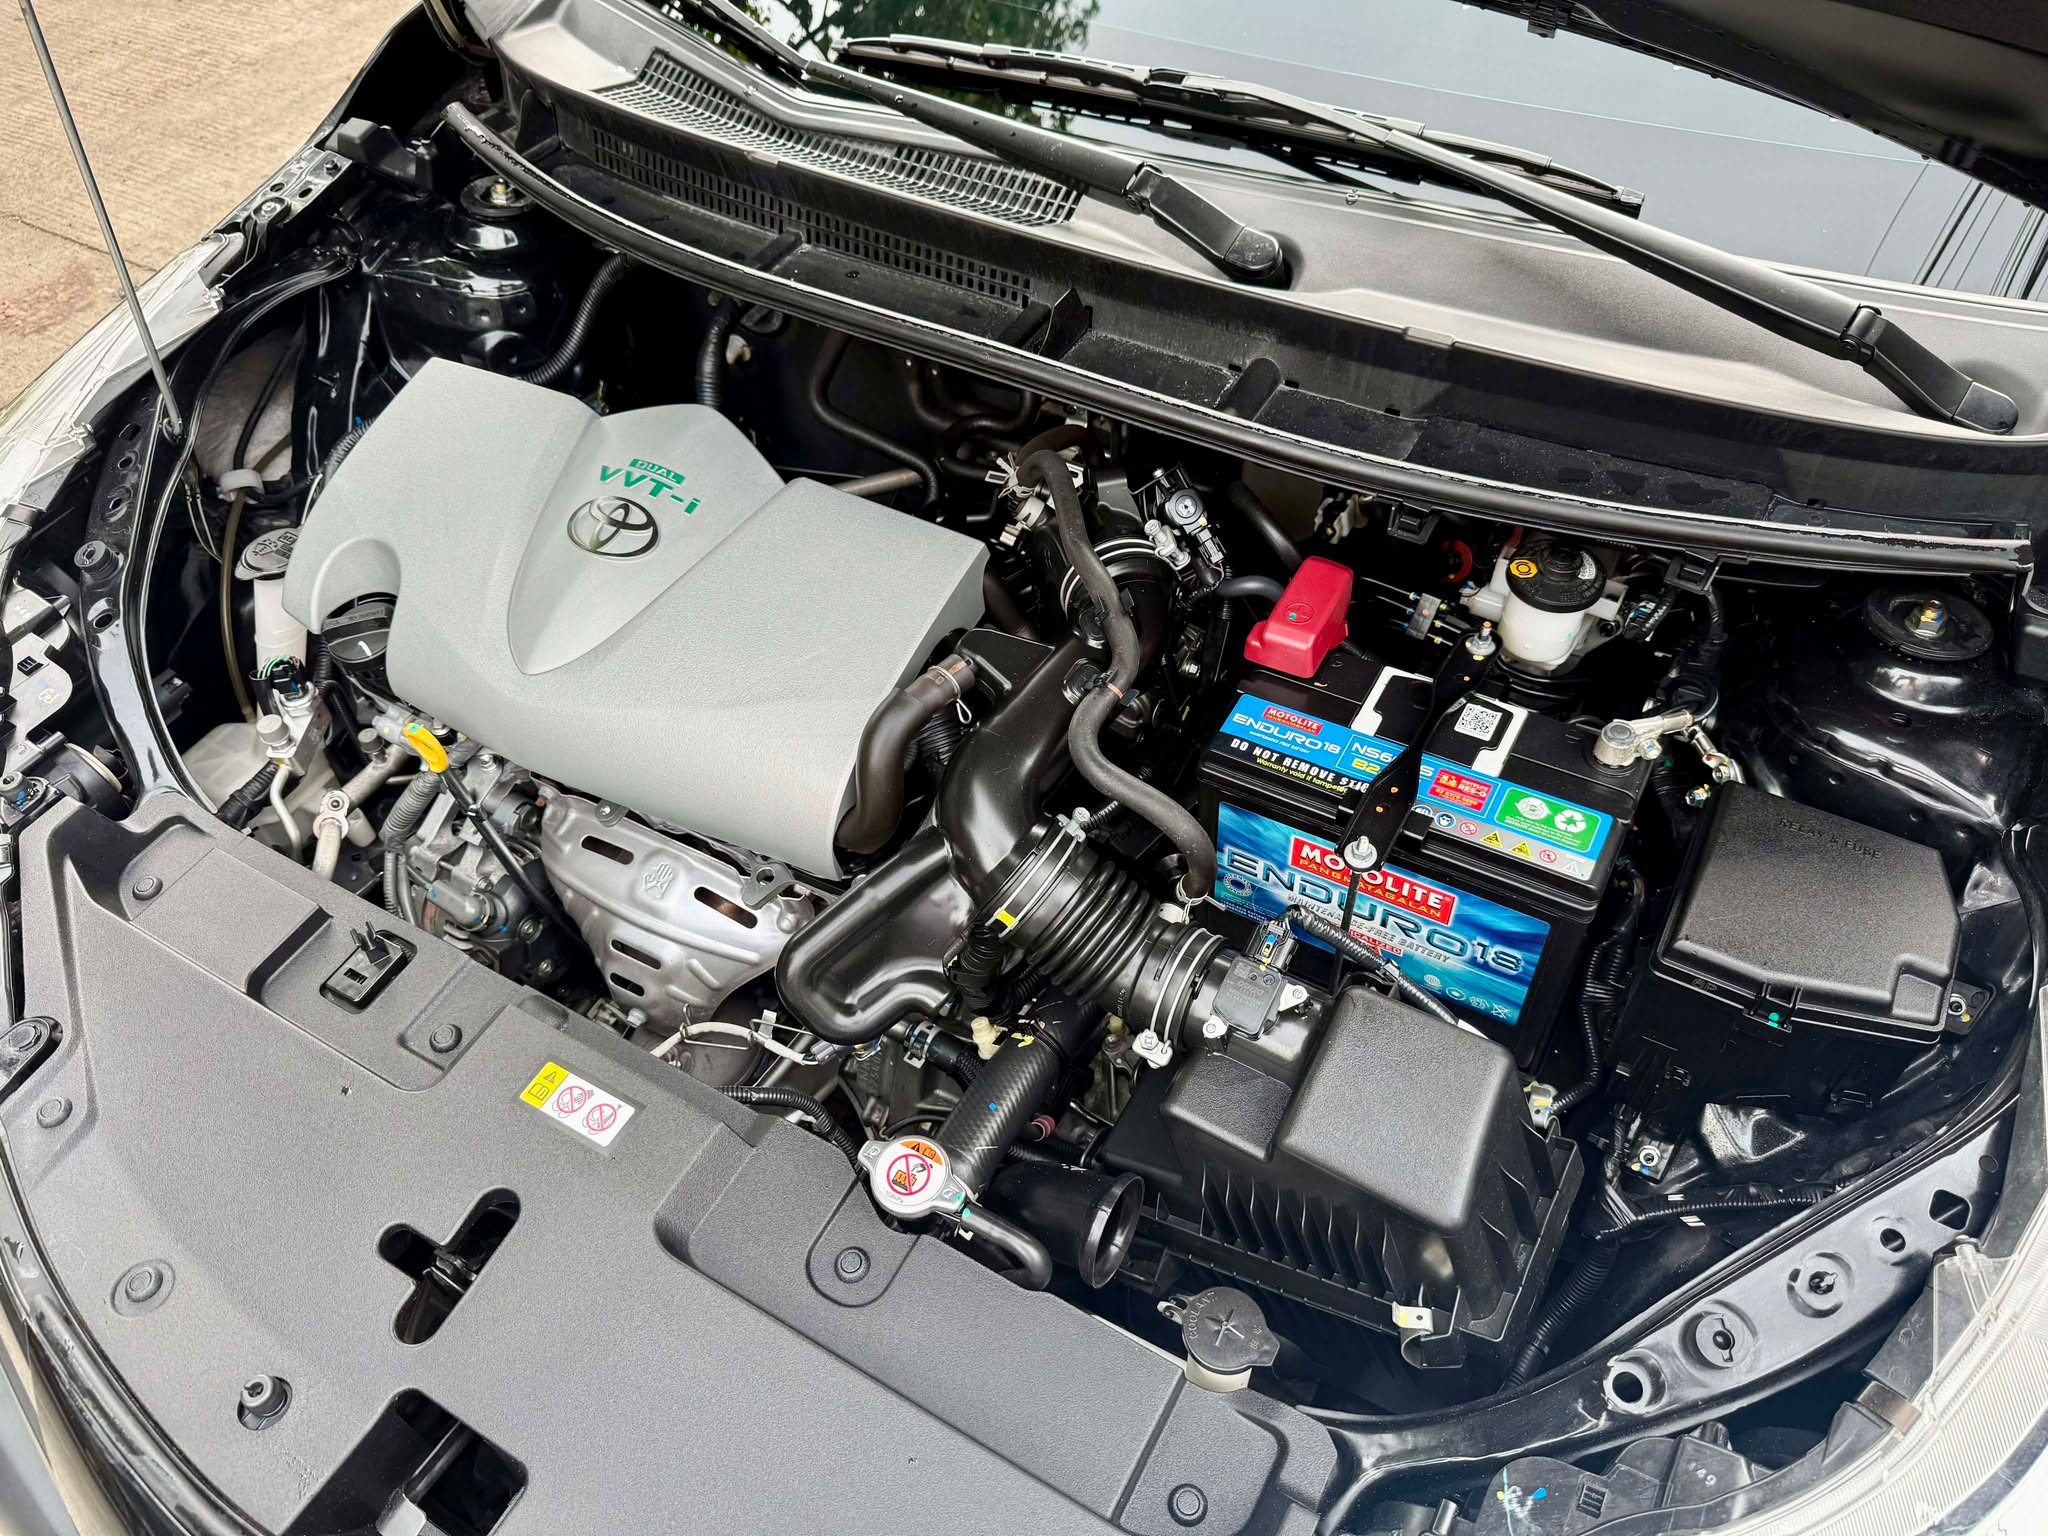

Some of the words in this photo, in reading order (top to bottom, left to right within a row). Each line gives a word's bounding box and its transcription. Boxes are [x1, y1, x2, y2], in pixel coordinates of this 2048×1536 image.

[600, 465, 701, 515] VVT-i
[636, 460, 677, 482] DUAL
[1268, 707, 1319, 730] MOTOLITE
[1230, 738, 1249, 752] DO
[1253, 746, 1279, 763] NOT
[1283, 757, 1335, 782] REMOVE
[1256, 756, 1288, 775] Warranty
[1289, 766, 1305, 780] void
[1351, 758, 1381, 775] B2
[1779, 817, 1825, 837] RELAY
[1844, 839, 1881, 860] FUSE
[1300, 844, 1443, 910] MOOLITE
[1288, 894, 1400, 943] MAINTENACE-FREE
[1398, 938, 1450, 963] BATTERY
[1188, 1290, 1219, 1340] COOLANT
